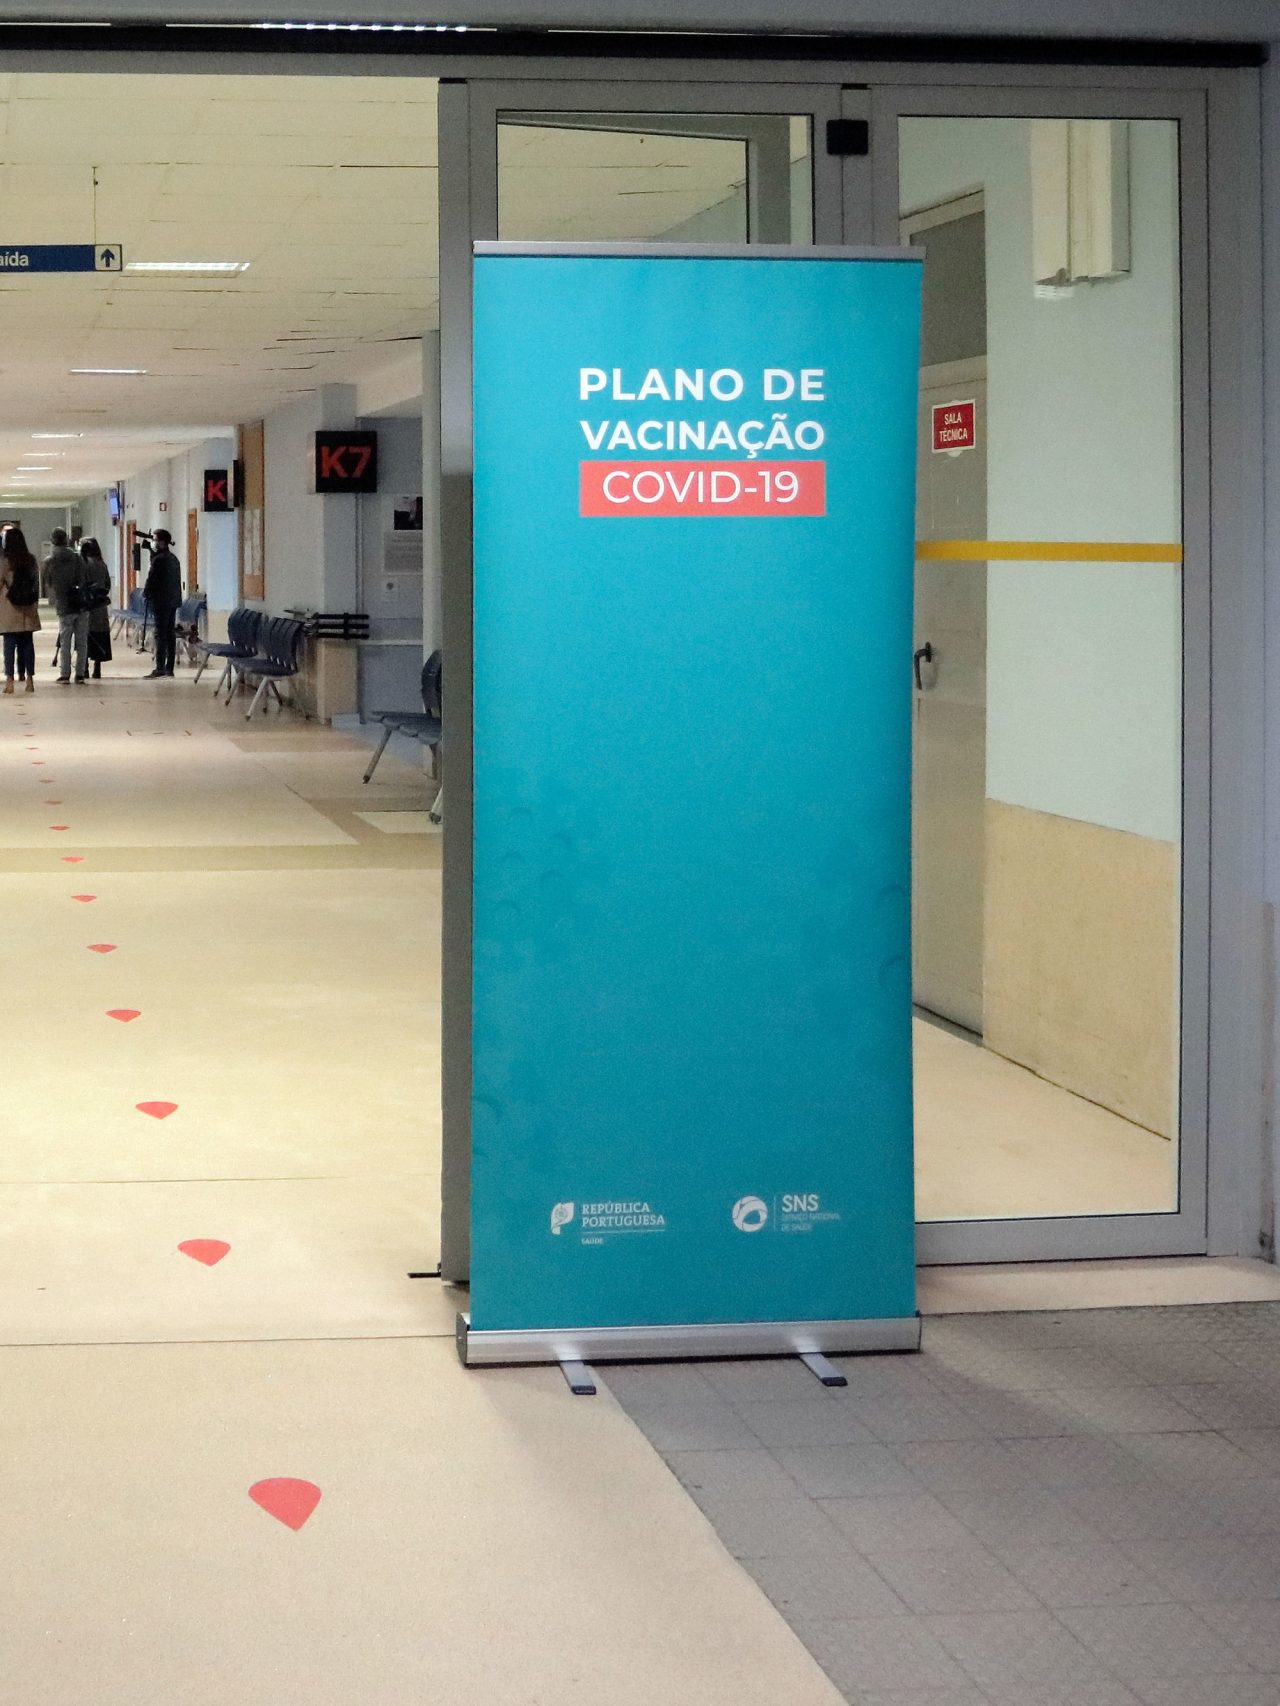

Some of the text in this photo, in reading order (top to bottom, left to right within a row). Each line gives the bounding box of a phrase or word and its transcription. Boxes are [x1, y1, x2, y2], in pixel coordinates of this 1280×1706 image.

[579, 367, 825, 401] PLANO DE
[944, 412, 962, 425] SALA
[579, 412, 825, 459] VACINAÇÃO
[321, 446, 371, 478] K7
[602, 471, 799, 503] COVID-19
[582, 1201, 650, 1215] REPÚBLICA
[782, 1194, 819, 1212] SNS
[582, 1214, 666, 1228] PORTUGUESA
